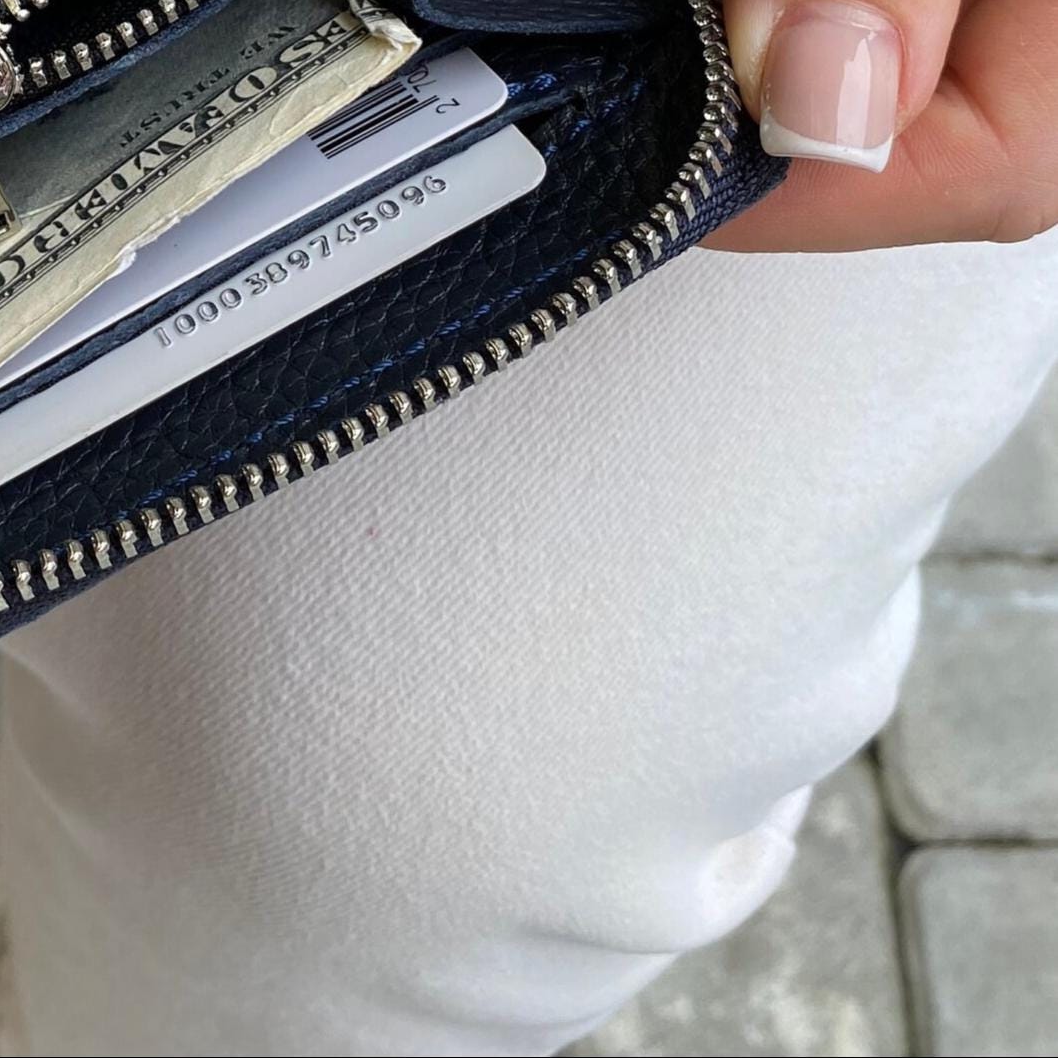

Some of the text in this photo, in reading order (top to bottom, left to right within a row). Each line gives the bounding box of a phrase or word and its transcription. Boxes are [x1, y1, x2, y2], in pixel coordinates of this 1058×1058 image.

[119, 25, 296, 148] WE TRUST
[196, 66, 277, 134] OF
[435, 97, 461, 114] 2
